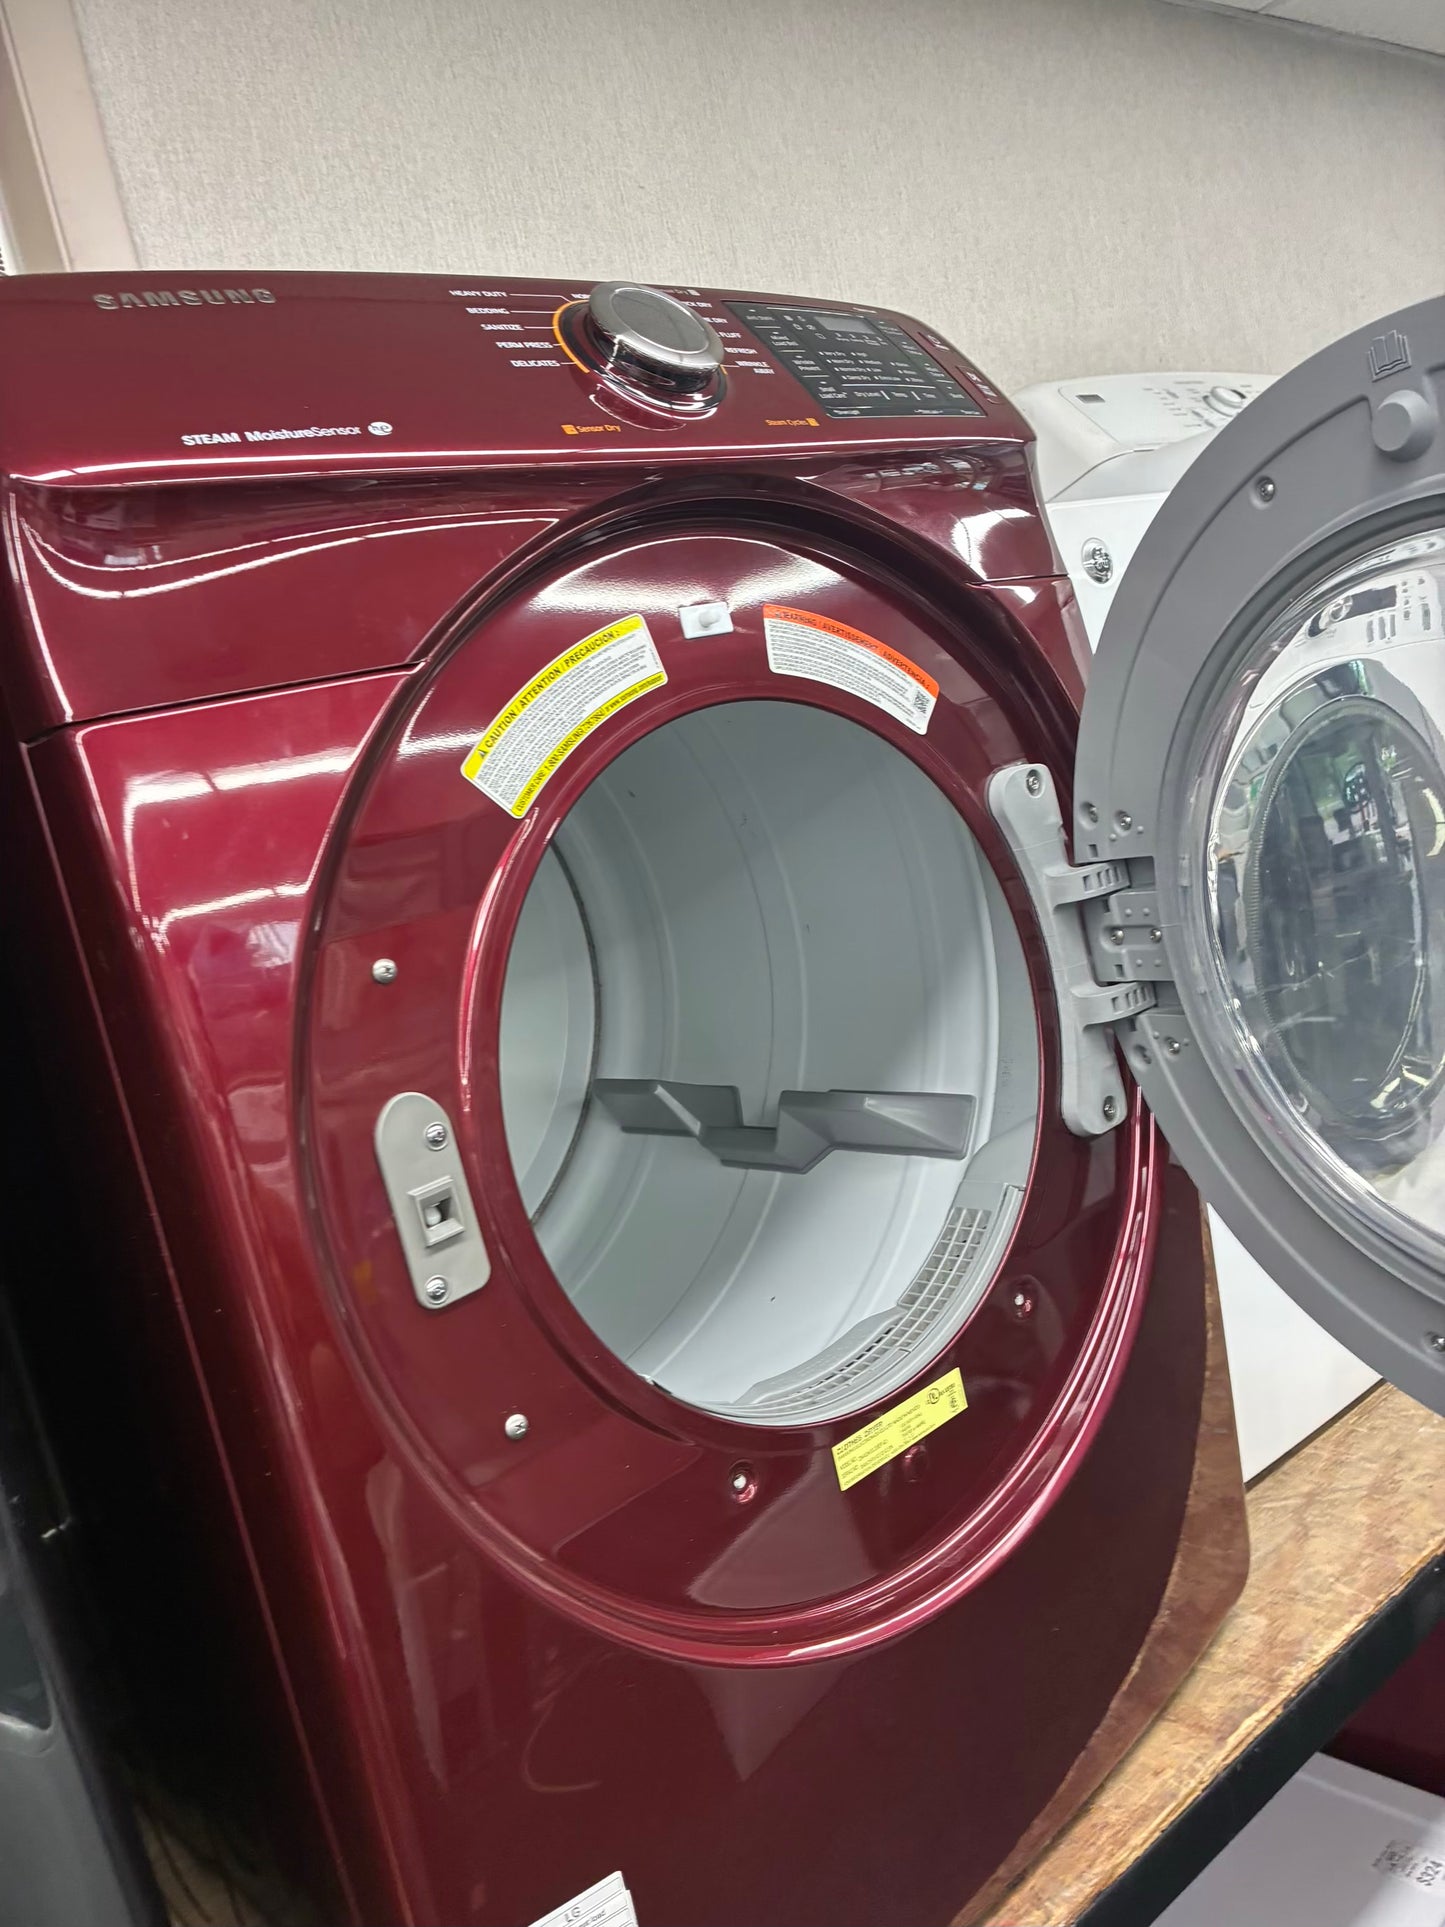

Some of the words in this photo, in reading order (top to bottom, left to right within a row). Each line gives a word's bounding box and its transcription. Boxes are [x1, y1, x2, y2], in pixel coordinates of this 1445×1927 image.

[448, 290, 482, 298] HEAVY
[481, 290, 508, 298] DUTY
[93, 288, 276, 310] SAMSUNG
[465, 307, 510, 315] BEDDING
[480, 323, 525, 331] SANITIZE
[495, 341, 524, 349] PERM
[522, 341, 554, 349] PRESS
[723, 347, 758, 355] REFRESH
[576, 425, 605, 433] Sensor
[603, 424, 621, 433] Dry
[181, 431, 242, 446] STEAM
[243, 426, 362, 442] MoistureSensor
[485, 711, 518, 749] CAUTION
[519, 666, 562, 708] ATTENTION
[563, 630, 614, 668] PRECAUCION
[564, 1906, 580, 1923] LG
